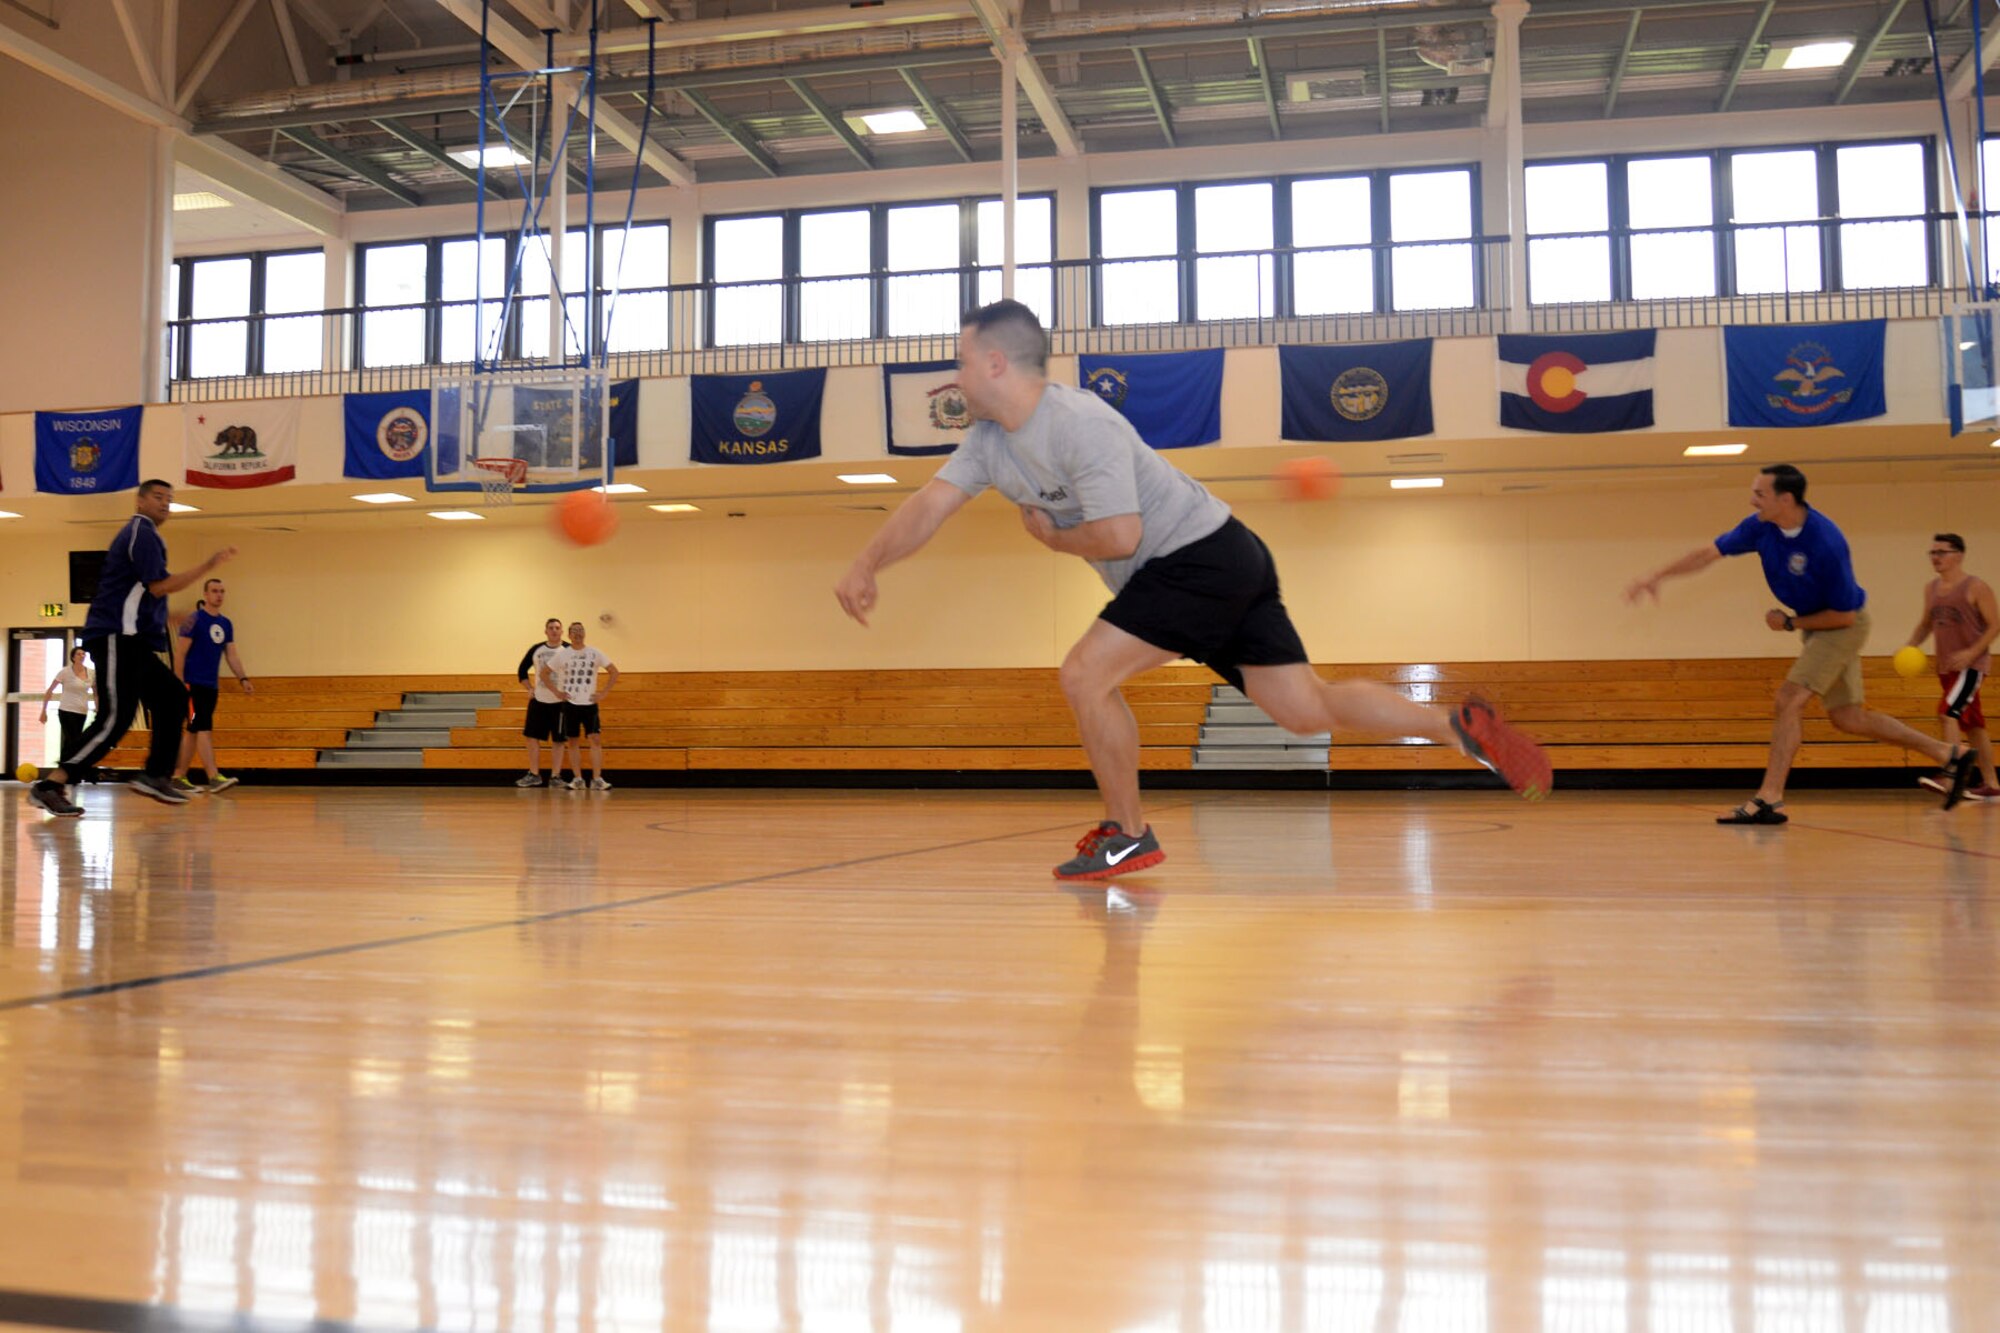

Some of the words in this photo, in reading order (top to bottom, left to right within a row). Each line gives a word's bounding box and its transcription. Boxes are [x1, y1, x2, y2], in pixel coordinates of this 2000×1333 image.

[52, 418, 121, 432] WISCONSIN
[719, 439, 789, 456] KANSAS
[70, 477, 97, 488] 1848
